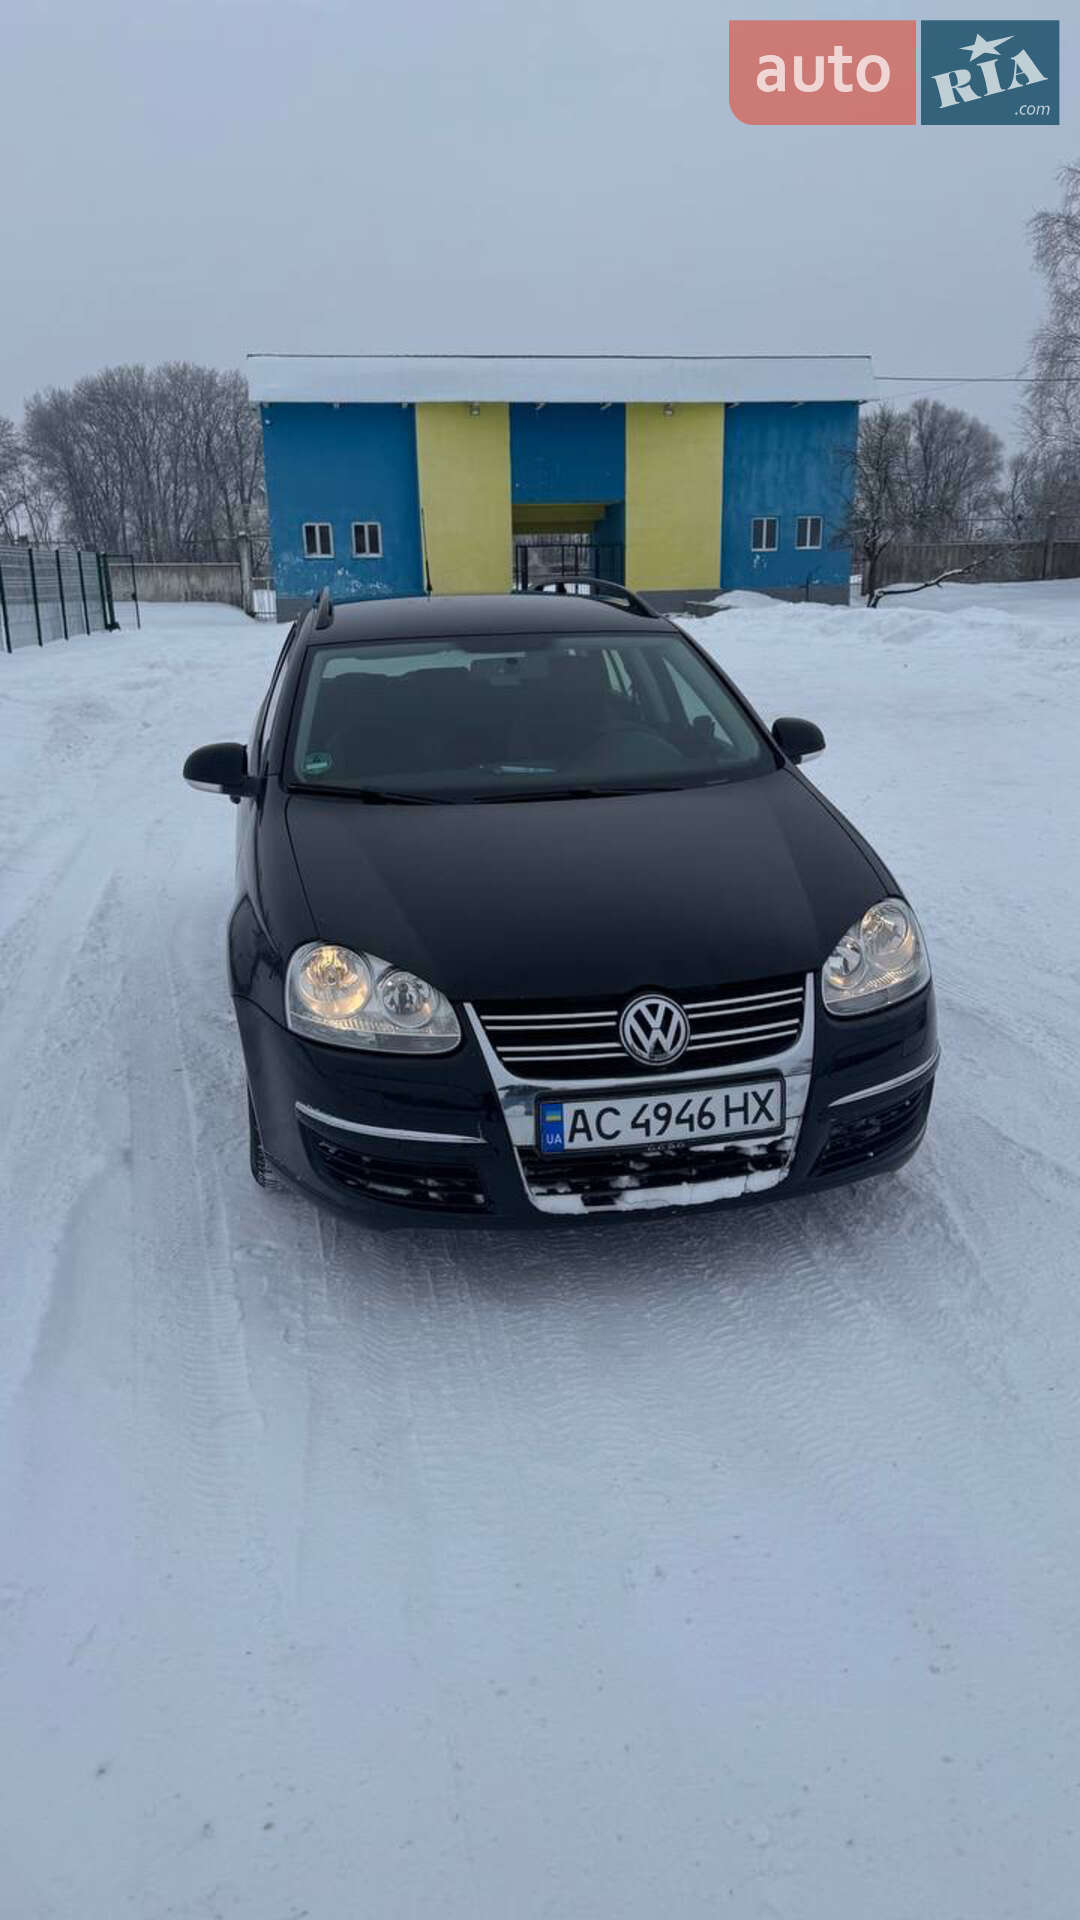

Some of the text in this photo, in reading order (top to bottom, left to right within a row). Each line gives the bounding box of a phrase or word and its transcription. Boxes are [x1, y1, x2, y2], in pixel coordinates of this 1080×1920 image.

[568, 1089, 775, 1143] AC 4946 HX
[546, 1133, 562, 1145] UA
